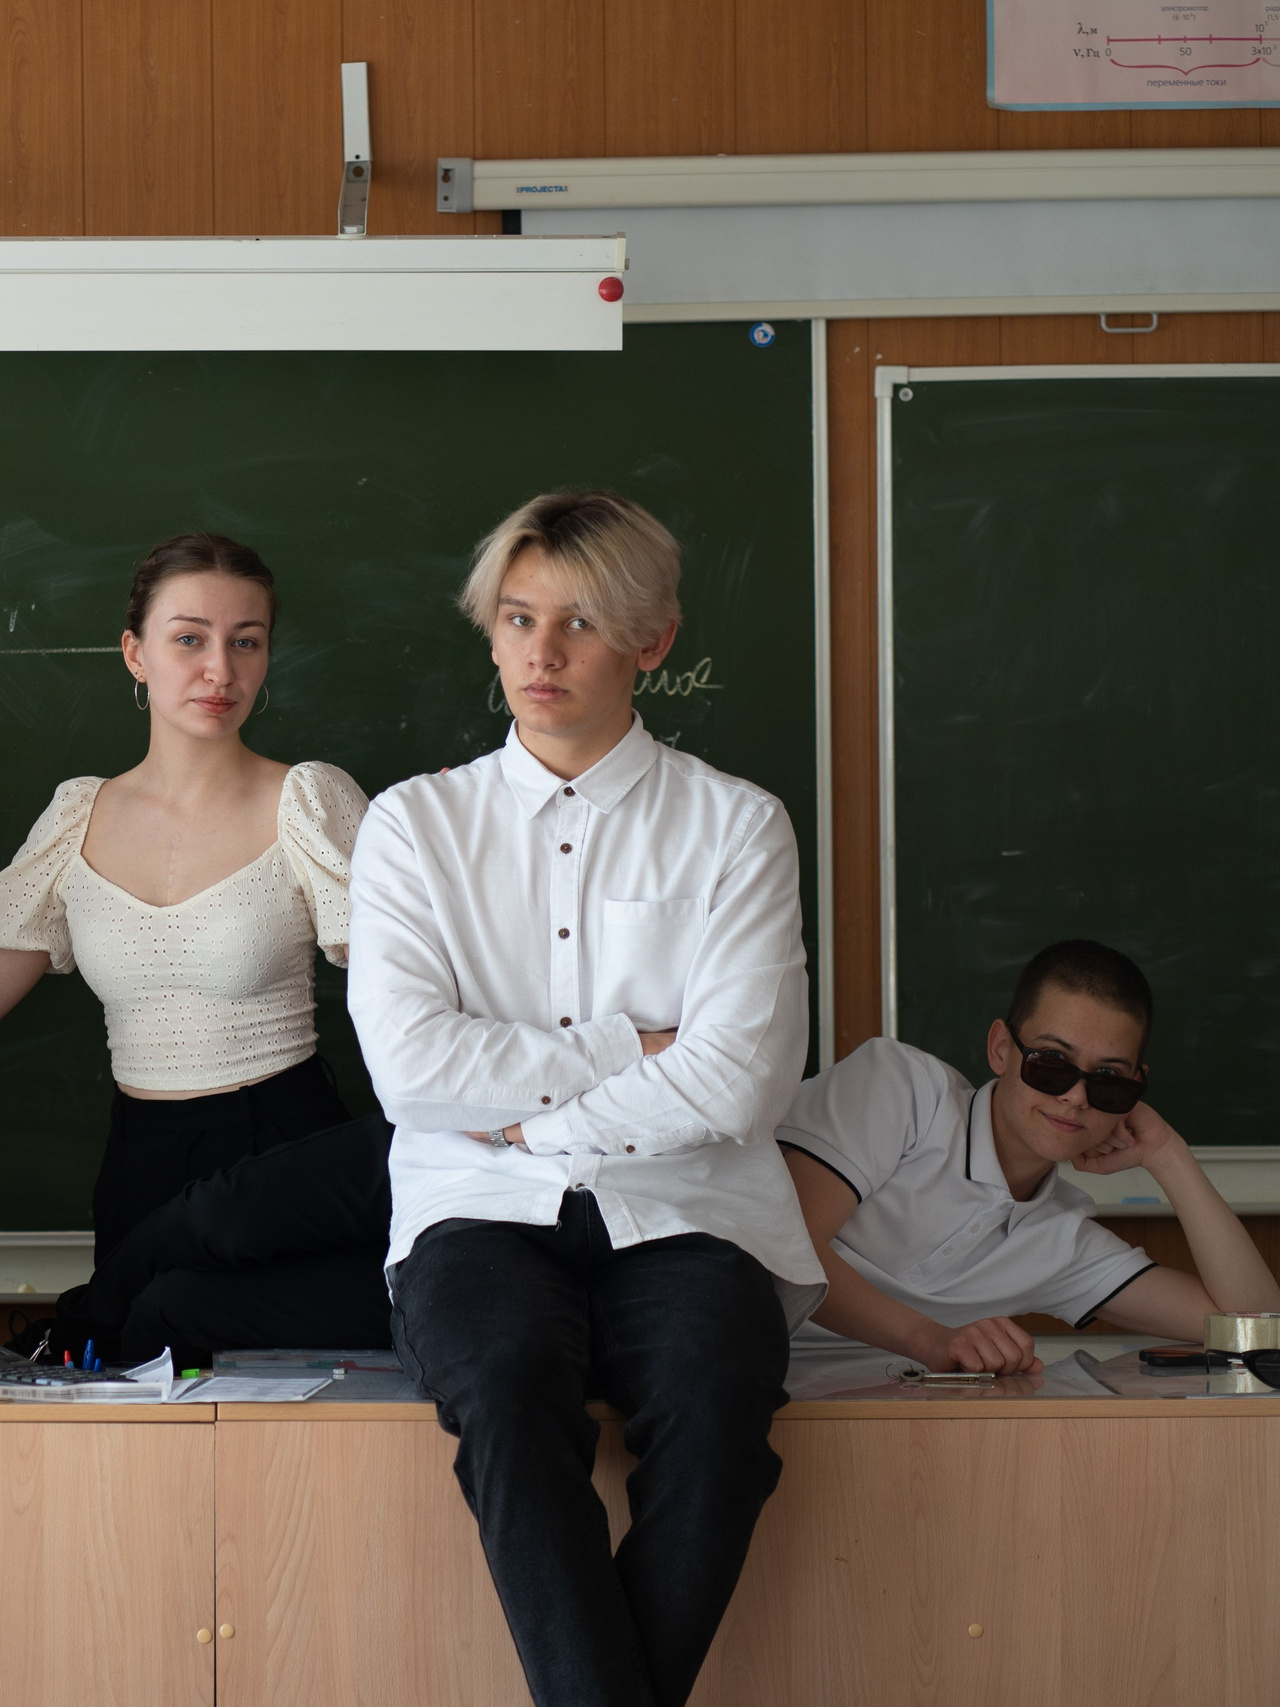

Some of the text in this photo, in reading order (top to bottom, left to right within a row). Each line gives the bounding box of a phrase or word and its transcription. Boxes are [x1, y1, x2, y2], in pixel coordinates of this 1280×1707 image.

[1179, 47, 1192, 56] 50
[1146, 79, 1227, 88] переменные токи
[519, 185, 564, 193] PROJECTA
